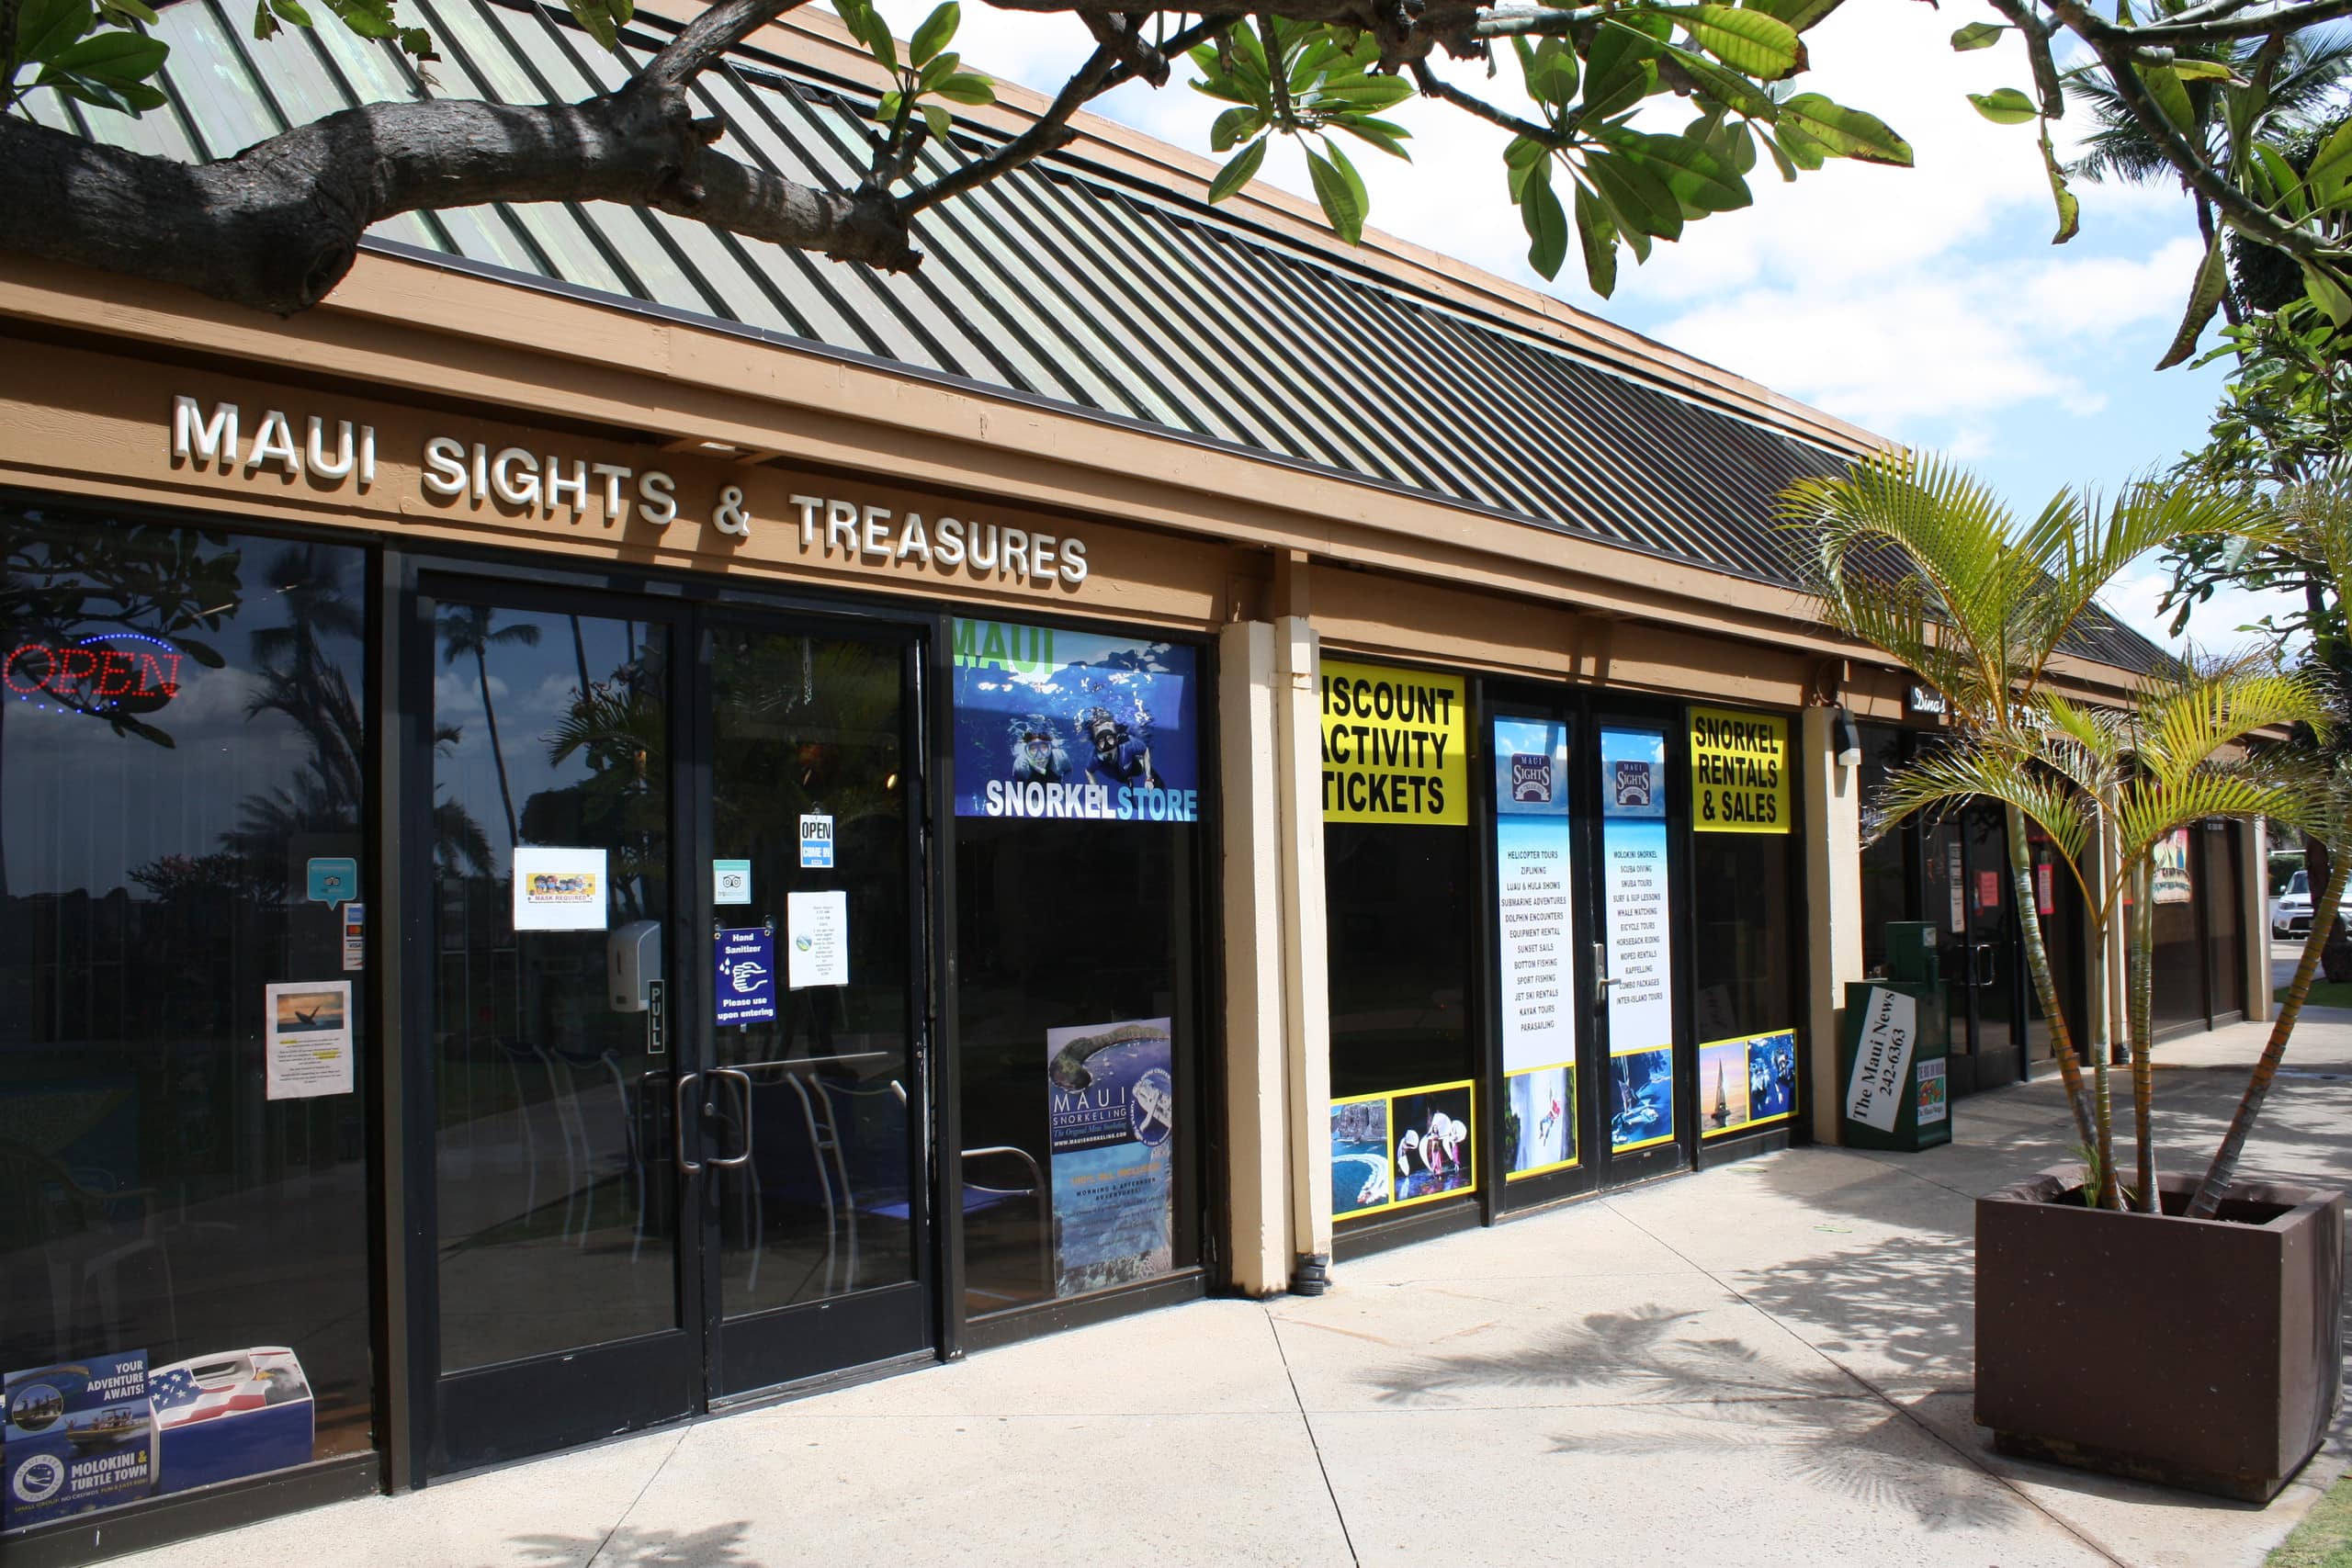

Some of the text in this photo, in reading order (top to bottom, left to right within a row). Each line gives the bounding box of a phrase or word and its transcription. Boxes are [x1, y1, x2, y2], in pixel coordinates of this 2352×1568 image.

[171, 395, 1088, 585] MAUI SIGHTS & TREASURES
[952, 618, 1054, 675] MAUI
[4, 644, 184, 700] OPEN
[1322, 675, 1454, 726] ISCOUNT
[1915, 686, 1946, 716] Dina's
[1695, 716, 1779, 754] SNORKEL
[1521, 756, 1543, 765] MAUI
[1698, 753, 1778, 789] RENTALS
[1513, 764, 1550, 786] SIGHTS
[1617, 771, 1649, 791] SIGHTS
[987, 780, 1197, 821] SNORKELSTORE
[1322, 770, 1444, 815] TICKETS
[1702, 790, 1777, 823] & SALES
[802, 821, 831, 840] OPEN
[1508, 851, 1558, 860] HELICOPTER TOURS
[725, 945, 762, 954] Sanitizer
[732, 933, 754, 942] Hand
[718, 1008, 775, 1021] upon entering
[723, 997, 768, 1008] Please use
[650, 987, 662, 1047] PULL
[1852, 991, 1896, 1120] The Maui News
[1879, 1028, 1906, 1098] 242-6363
[1053, 1087, 1126, 1113] MAUI
[1053, 1108, 1127, 1126] SNORKELING
[116, 1359, 143, 1374] YOUR
[86, 1371, 144, 1393] ADVENTURE
[104, 1383, 144, 1402] AWAITS!
[71, 1450, 148, 1478] MOLOKINI &
[71, 1473, 113, 1492] TURTLE
[114, 1464, 148, 1481] TOWN
